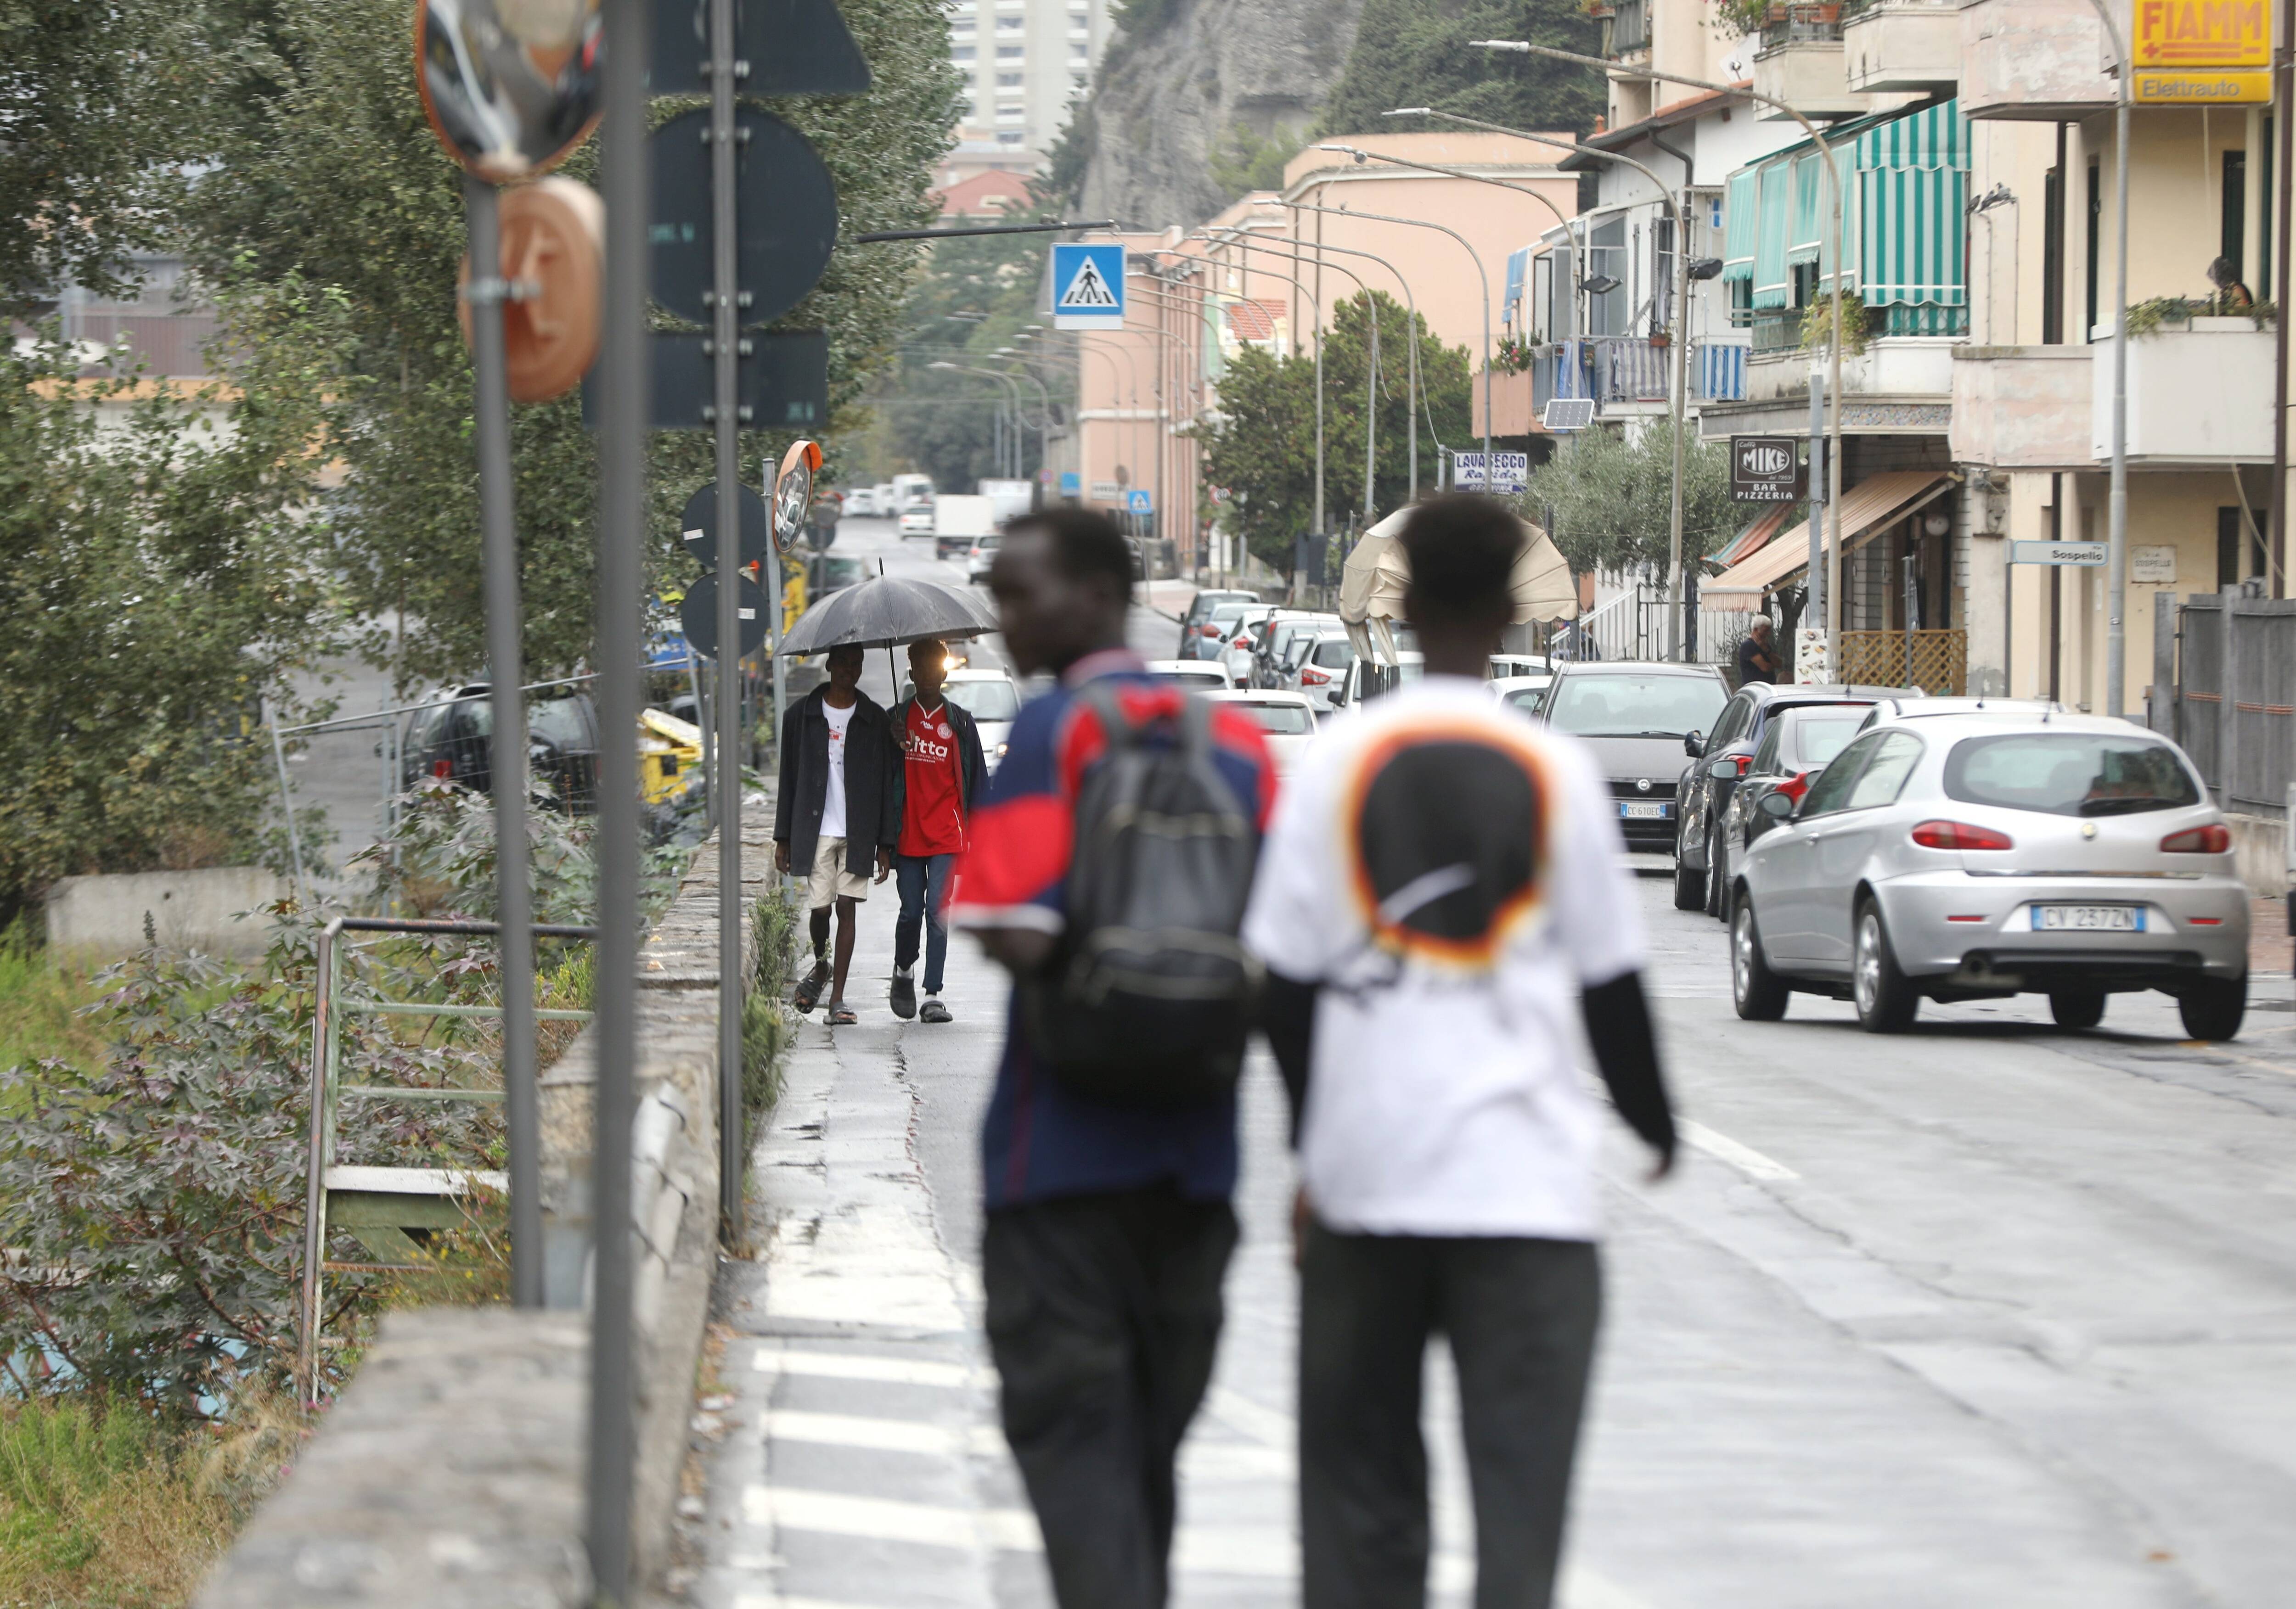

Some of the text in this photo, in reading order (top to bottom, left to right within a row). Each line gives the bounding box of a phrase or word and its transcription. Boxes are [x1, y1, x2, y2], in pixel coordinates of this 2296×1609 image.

[2142, 1, 2262, 40] FIAMM
[2142, 79, 2240, 97] Elettrauto
[1457, 454, 1525, 468] LAVAECCO
[1743, 447, 1785, 472] MIKE
[1737, 491, 1793, 500] PIZZERIA
[2052, 549, 2103, 561] Sospello
[2046, 908, 2133, 927] CV 237ZN
